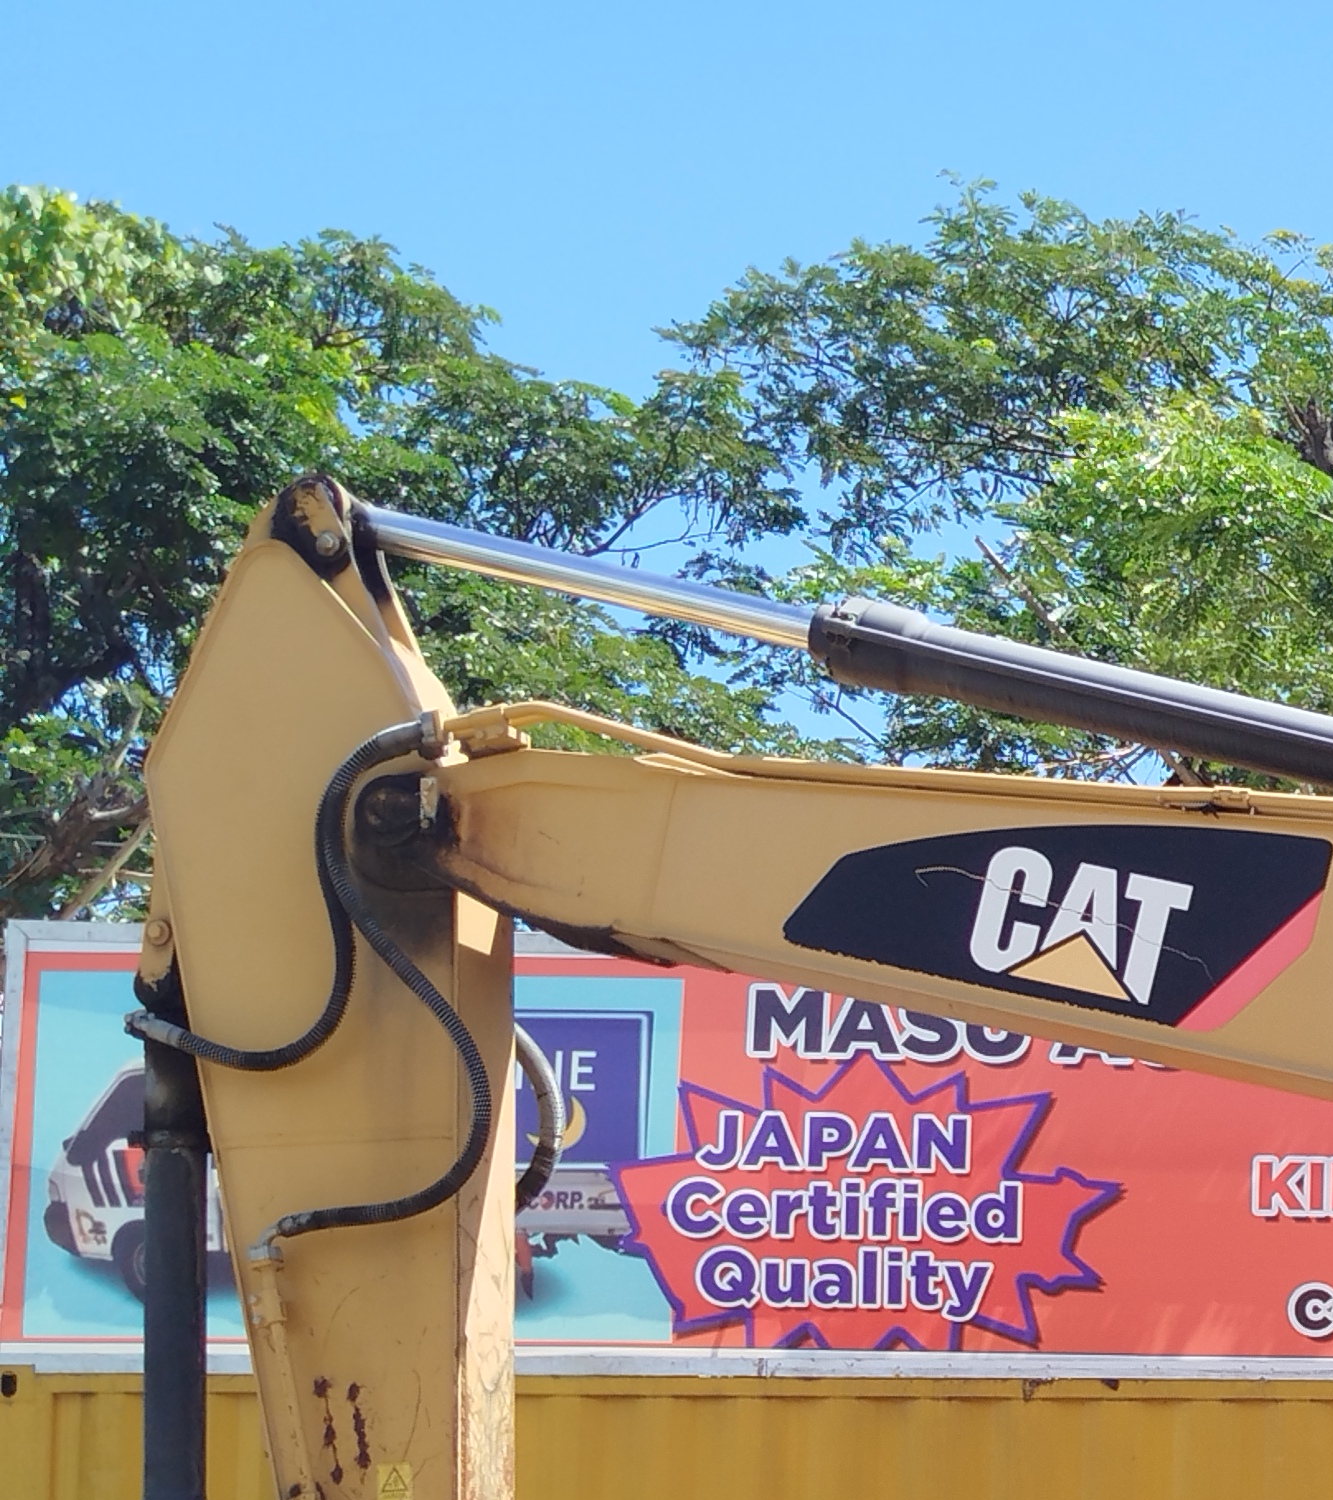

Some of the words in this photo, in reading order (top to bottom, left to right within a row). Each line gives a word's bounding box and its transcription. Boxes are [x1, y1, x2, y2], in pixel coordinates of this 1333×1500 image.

[970, 847, 1193, 1004] CAT
[696, 1111, 972, 1175] JAPAN
[664, 1177, 1023, 1244] Certified
[697, 1245, 994, 1322] Quality
